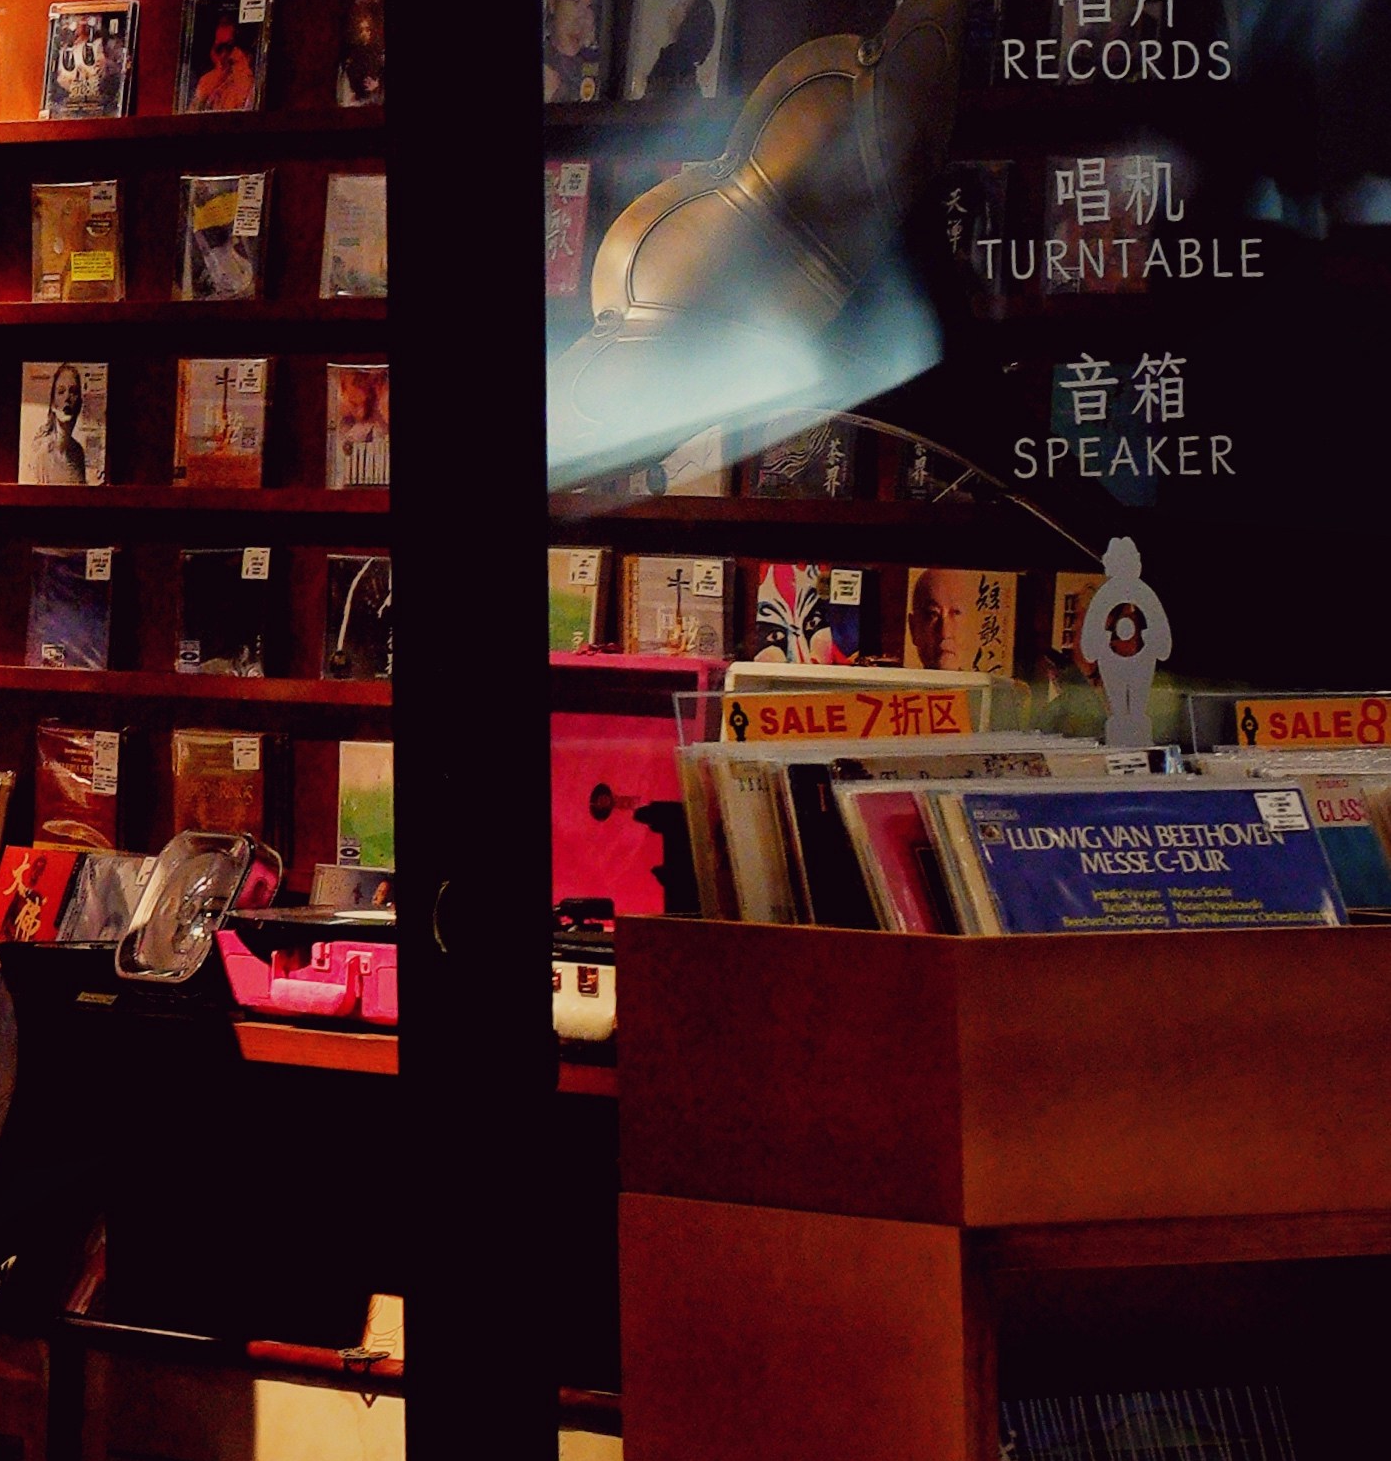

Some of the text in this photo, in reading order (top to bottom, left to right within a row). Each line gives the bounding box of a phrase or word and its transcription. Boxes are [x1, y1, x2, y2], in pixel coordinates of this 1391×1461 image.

[1002, 38, 1233, 82] RECORDS
[1054, 155, 1186, 227] 唱机
[976, 237, 1266, 281] TURNTABLE
[1058, 351, 1189, 425] 音箱
[1012, 435, 1237, 480] SPEAKER
[760, 704, 848, 736] SALE
[1269, 710, 1354, 740] SALE
[1005, 822, 1286, 851] LUDWIG VAN BEETHOVEN
[1081, 849, 1230, 875] MESSE C-DUR
